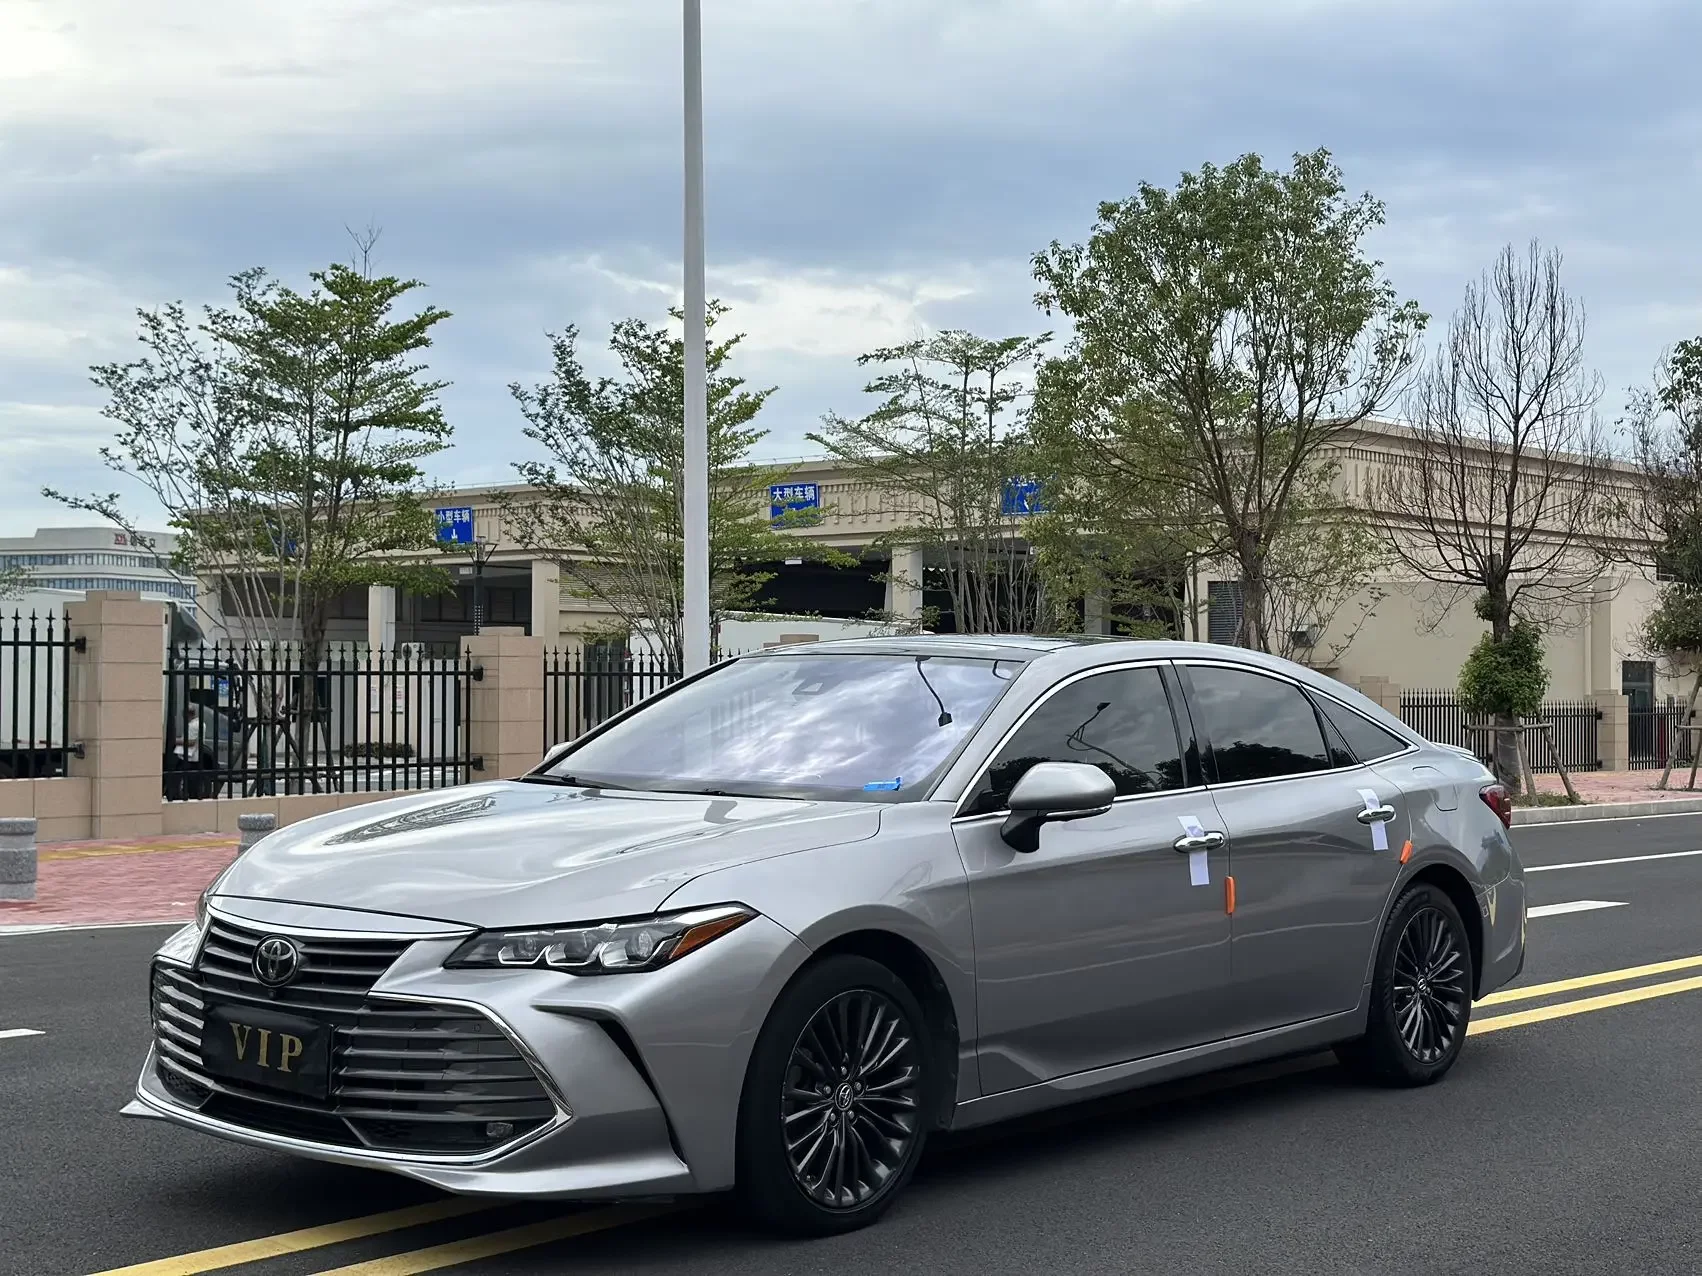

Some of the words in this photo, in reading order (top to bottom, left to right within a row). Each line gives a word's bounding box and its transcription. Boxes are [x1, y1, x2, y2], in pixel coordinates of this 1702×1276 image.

[773, 485, 815, 502] 大型车辆
[437, 509, 470, 524] 小型车辆
[229, 1022, 303, 1073] VIP
